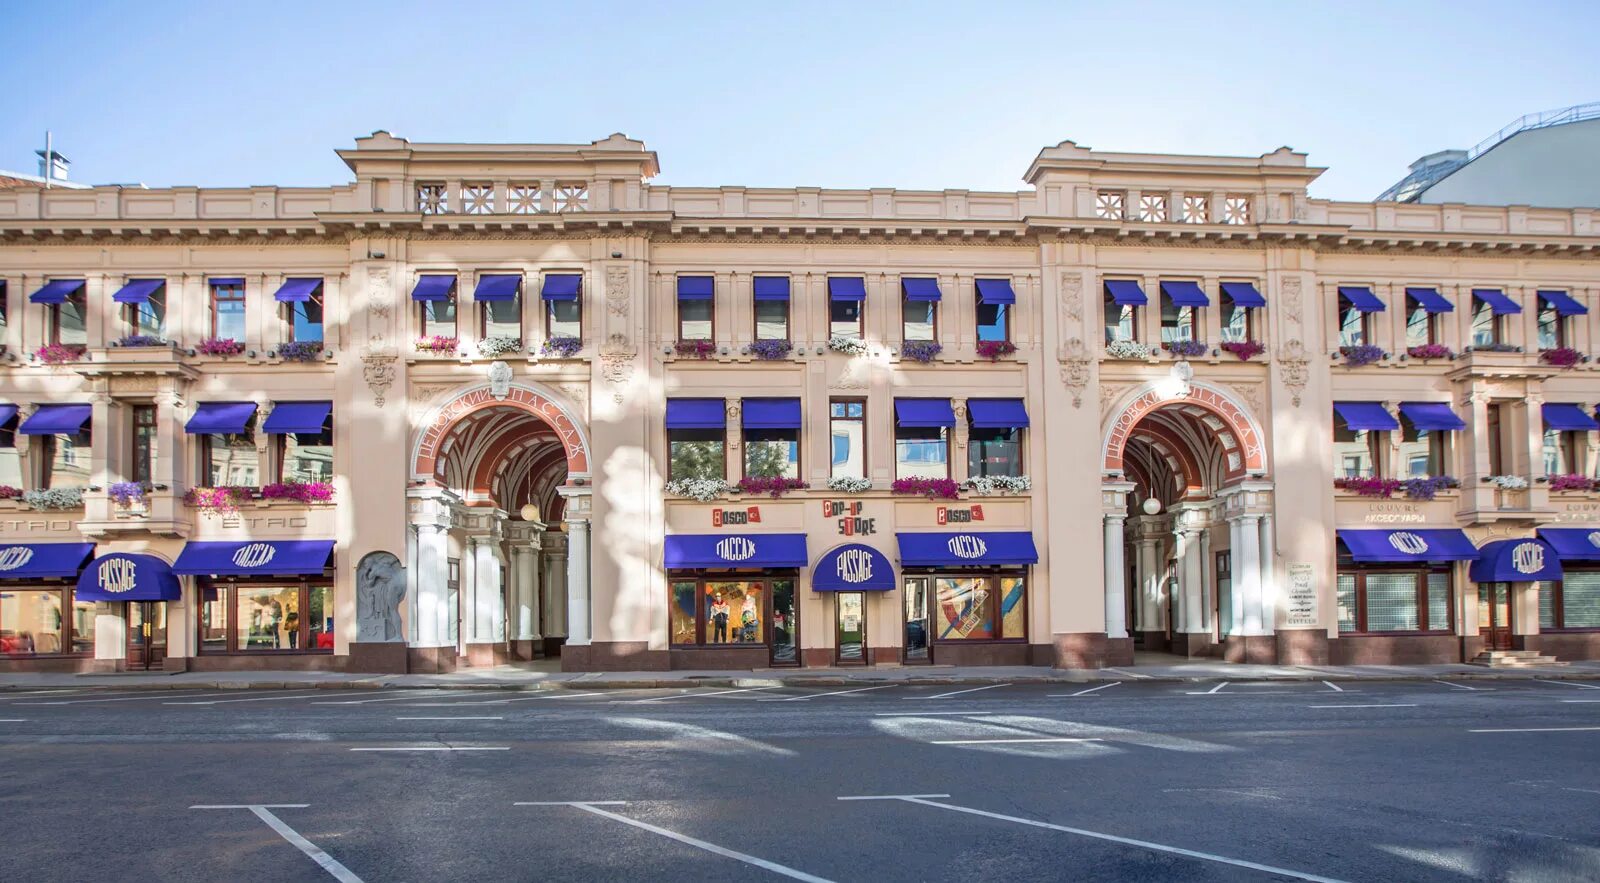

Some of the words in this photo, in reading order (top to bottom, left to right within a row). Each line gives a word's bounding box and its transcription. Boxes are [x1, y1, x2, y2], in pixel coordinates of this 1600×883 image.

[511, 388, 585, 459] ПАССАЖ
[1106, 390, 1172, 459] ПЕТРОВСКИ
[1191, 386, 1261, 459] ПАССАЖ
[713, 508, 748, 527] BOSCO
[823, 500, 862, 517] POP-UP
[937, 507, 971, 525] BOSCO
[838, 516, 876, 536] STORE
[232, 543, 276, 568] ПАССАЖ
[716, 537, 756, 561] ПАССАЖ
[948, 535, 987, 559] ПАССАЖ
[1512, 542, 1545, 574] PASSAGE
[98, 558, 137, 593] PASSAGE
[836, 548, 873, 583] PASSAGE
